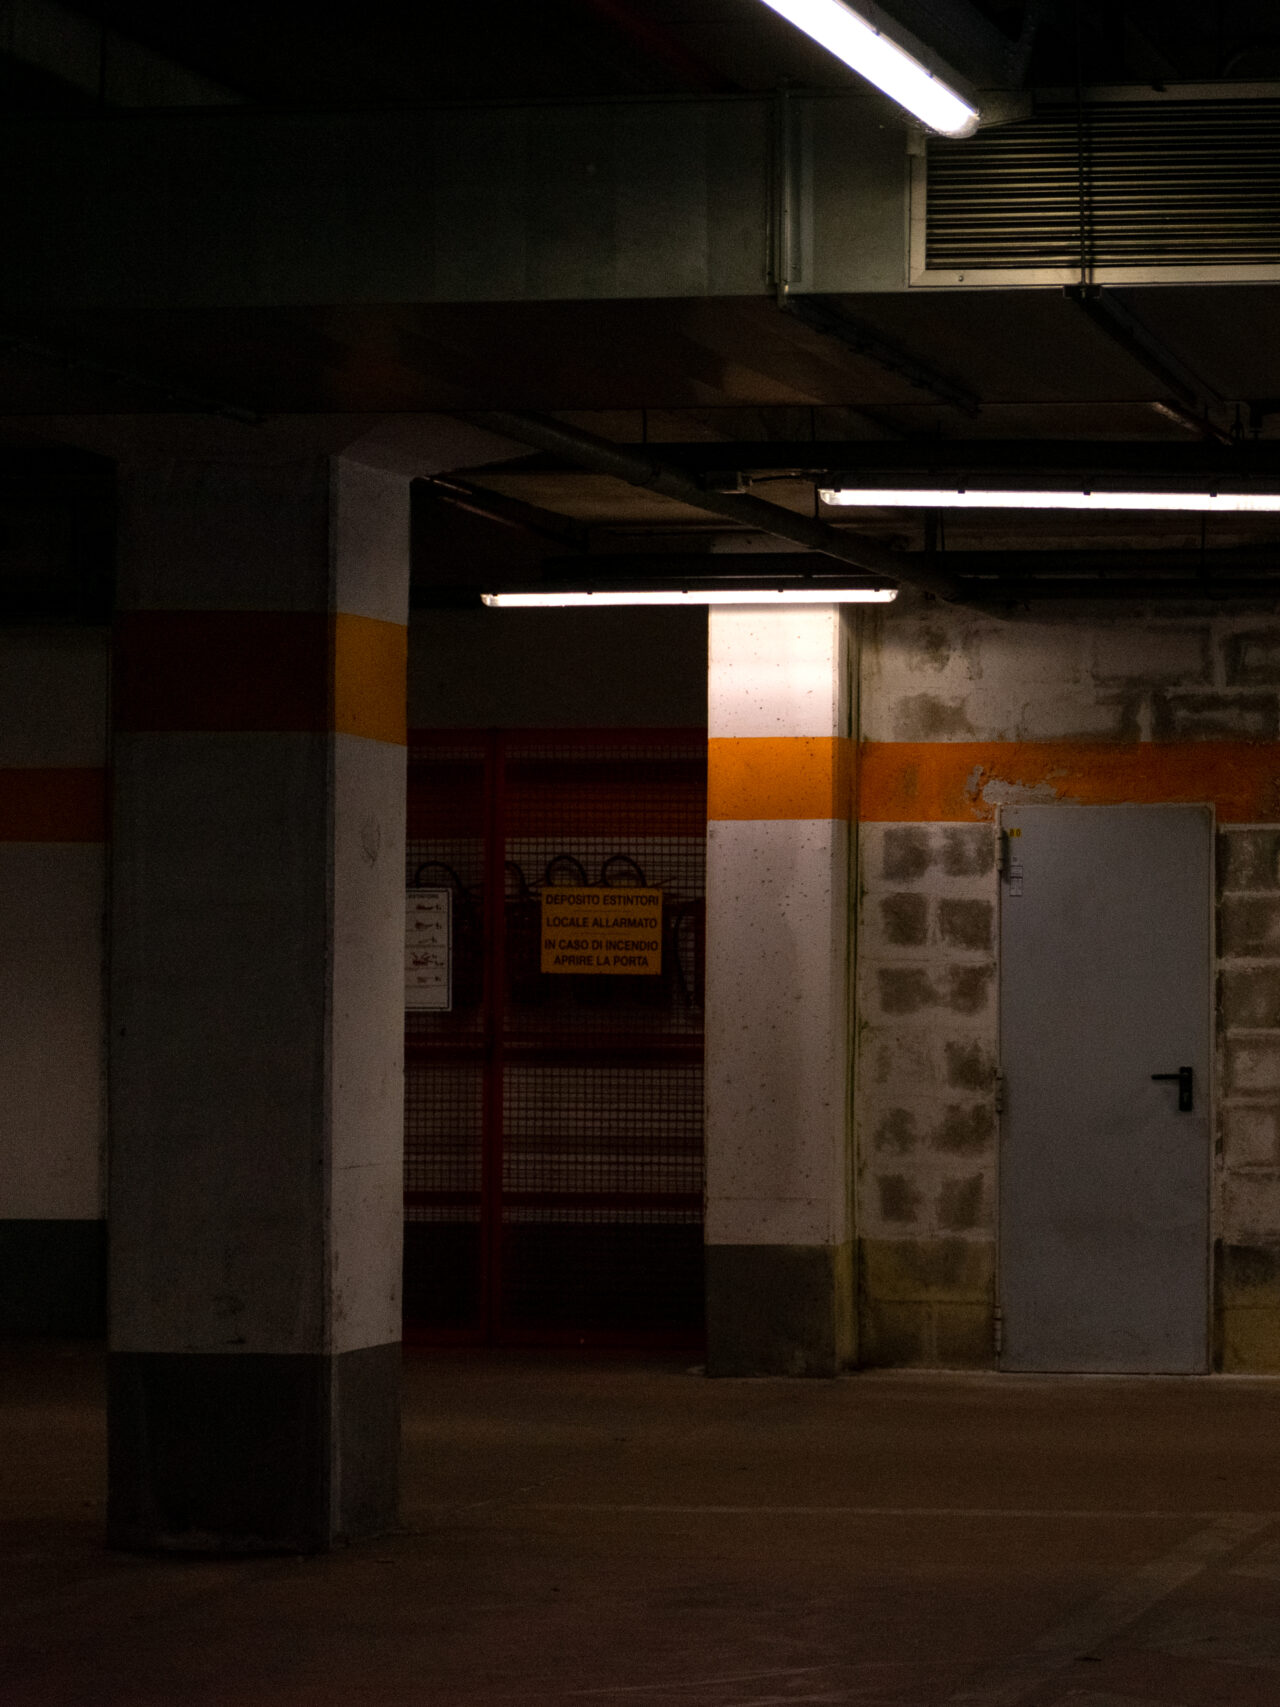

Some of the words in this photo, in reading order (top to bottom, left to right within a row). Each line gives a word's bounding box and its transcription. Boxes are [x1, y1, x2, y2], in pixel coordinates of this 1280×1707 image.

[545, 894, 600, 905] DEPOSITO
[603, 894, 659, 905] ESTINTORI
[546, 916, 589, 927] LOCALE
[592, 917, 658, 928] ALLARMATO
[544, 939, 555, 950] IN
[558, 939, 589, 950] CASO
[592, 940, 602, 950] DI
[606, 940, 659, 951] INCENDIO
[554, 955, 593, 966] APRIRE
[596, 955, 611, 966] LA
[613, 955, 649, 967] PORTA
